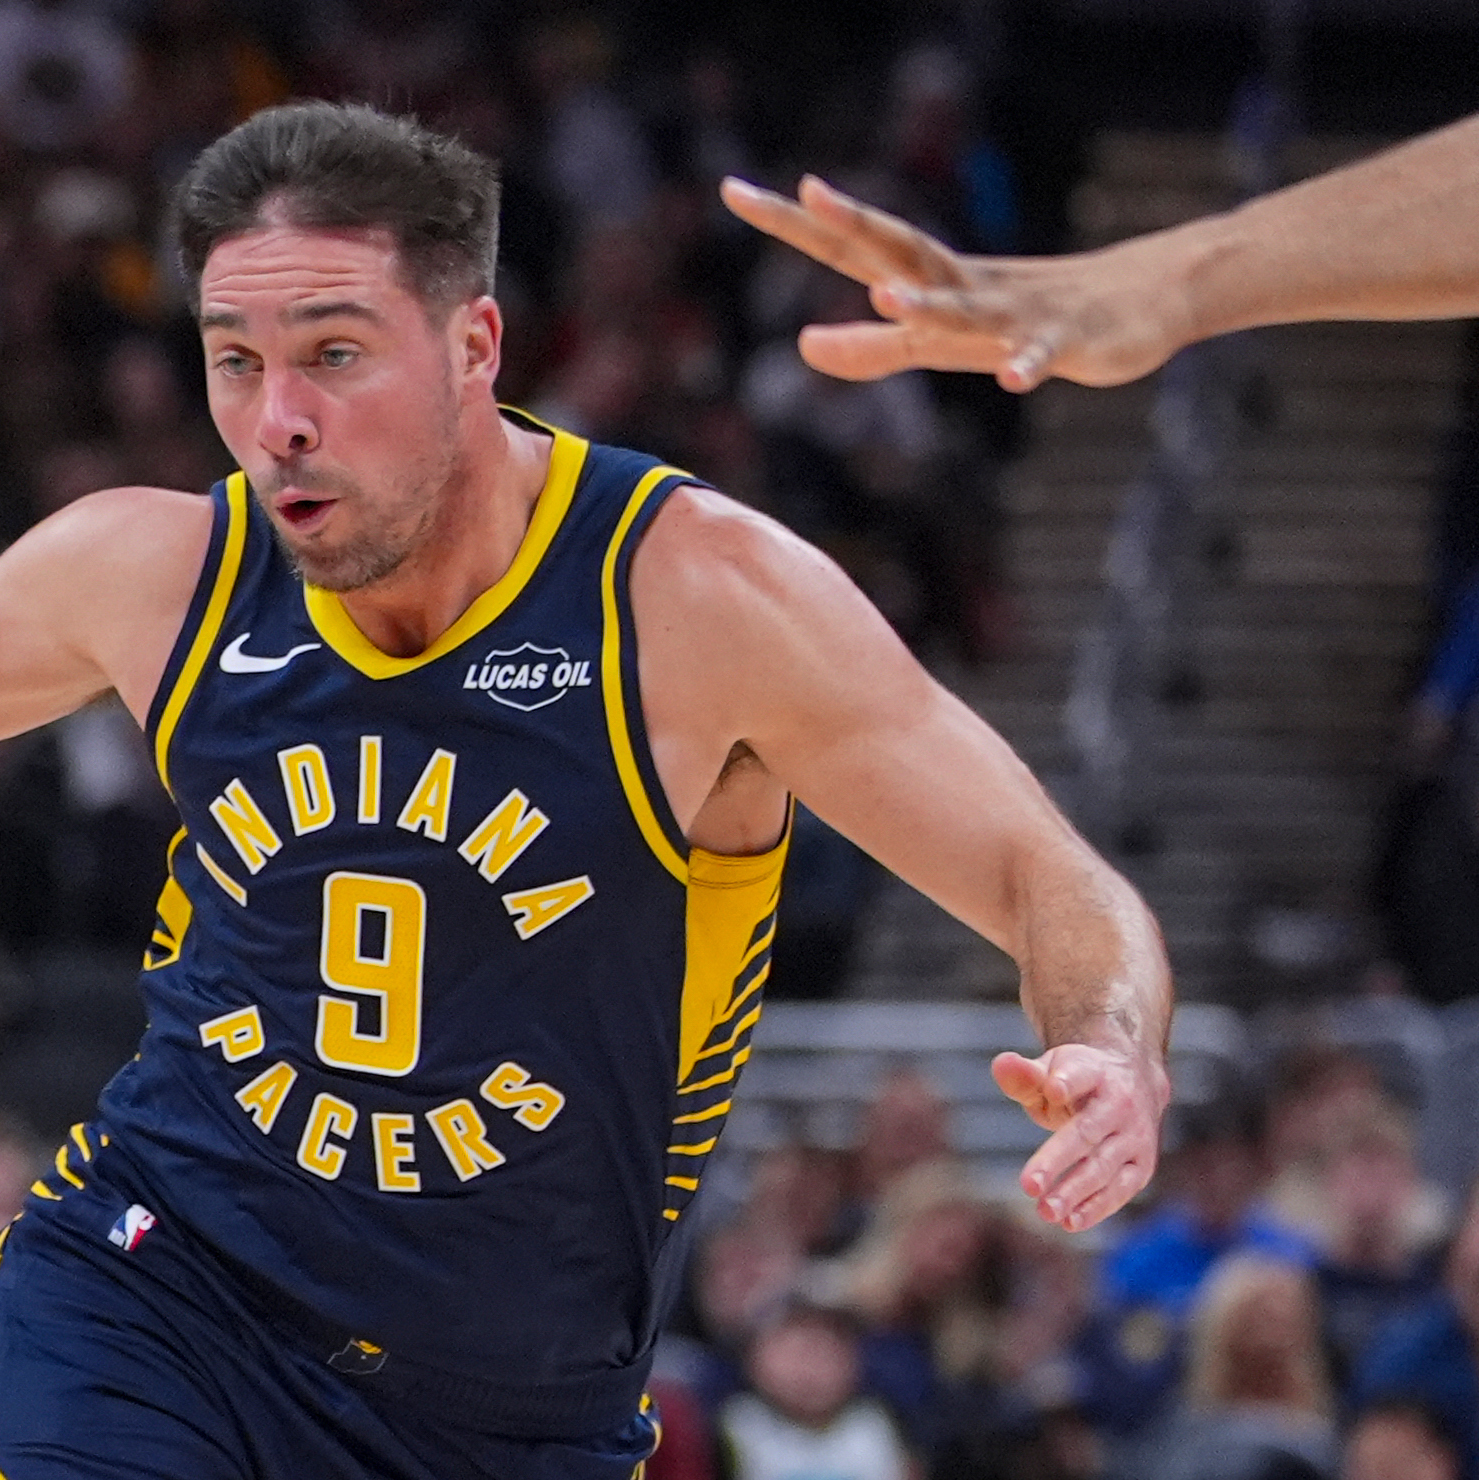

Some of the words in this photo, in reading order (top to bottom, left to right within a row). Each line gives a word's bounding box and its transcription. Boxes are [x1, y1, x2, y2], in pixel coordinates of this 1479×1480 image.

[462, 663, 548, 690] LUCAS
[552, 661, 592, 688] OIL
[196, 735, 595, 940] INDIANA
[315, 871, 426, 1077] 9
[199, 1005, 565, 1192] PACERS
